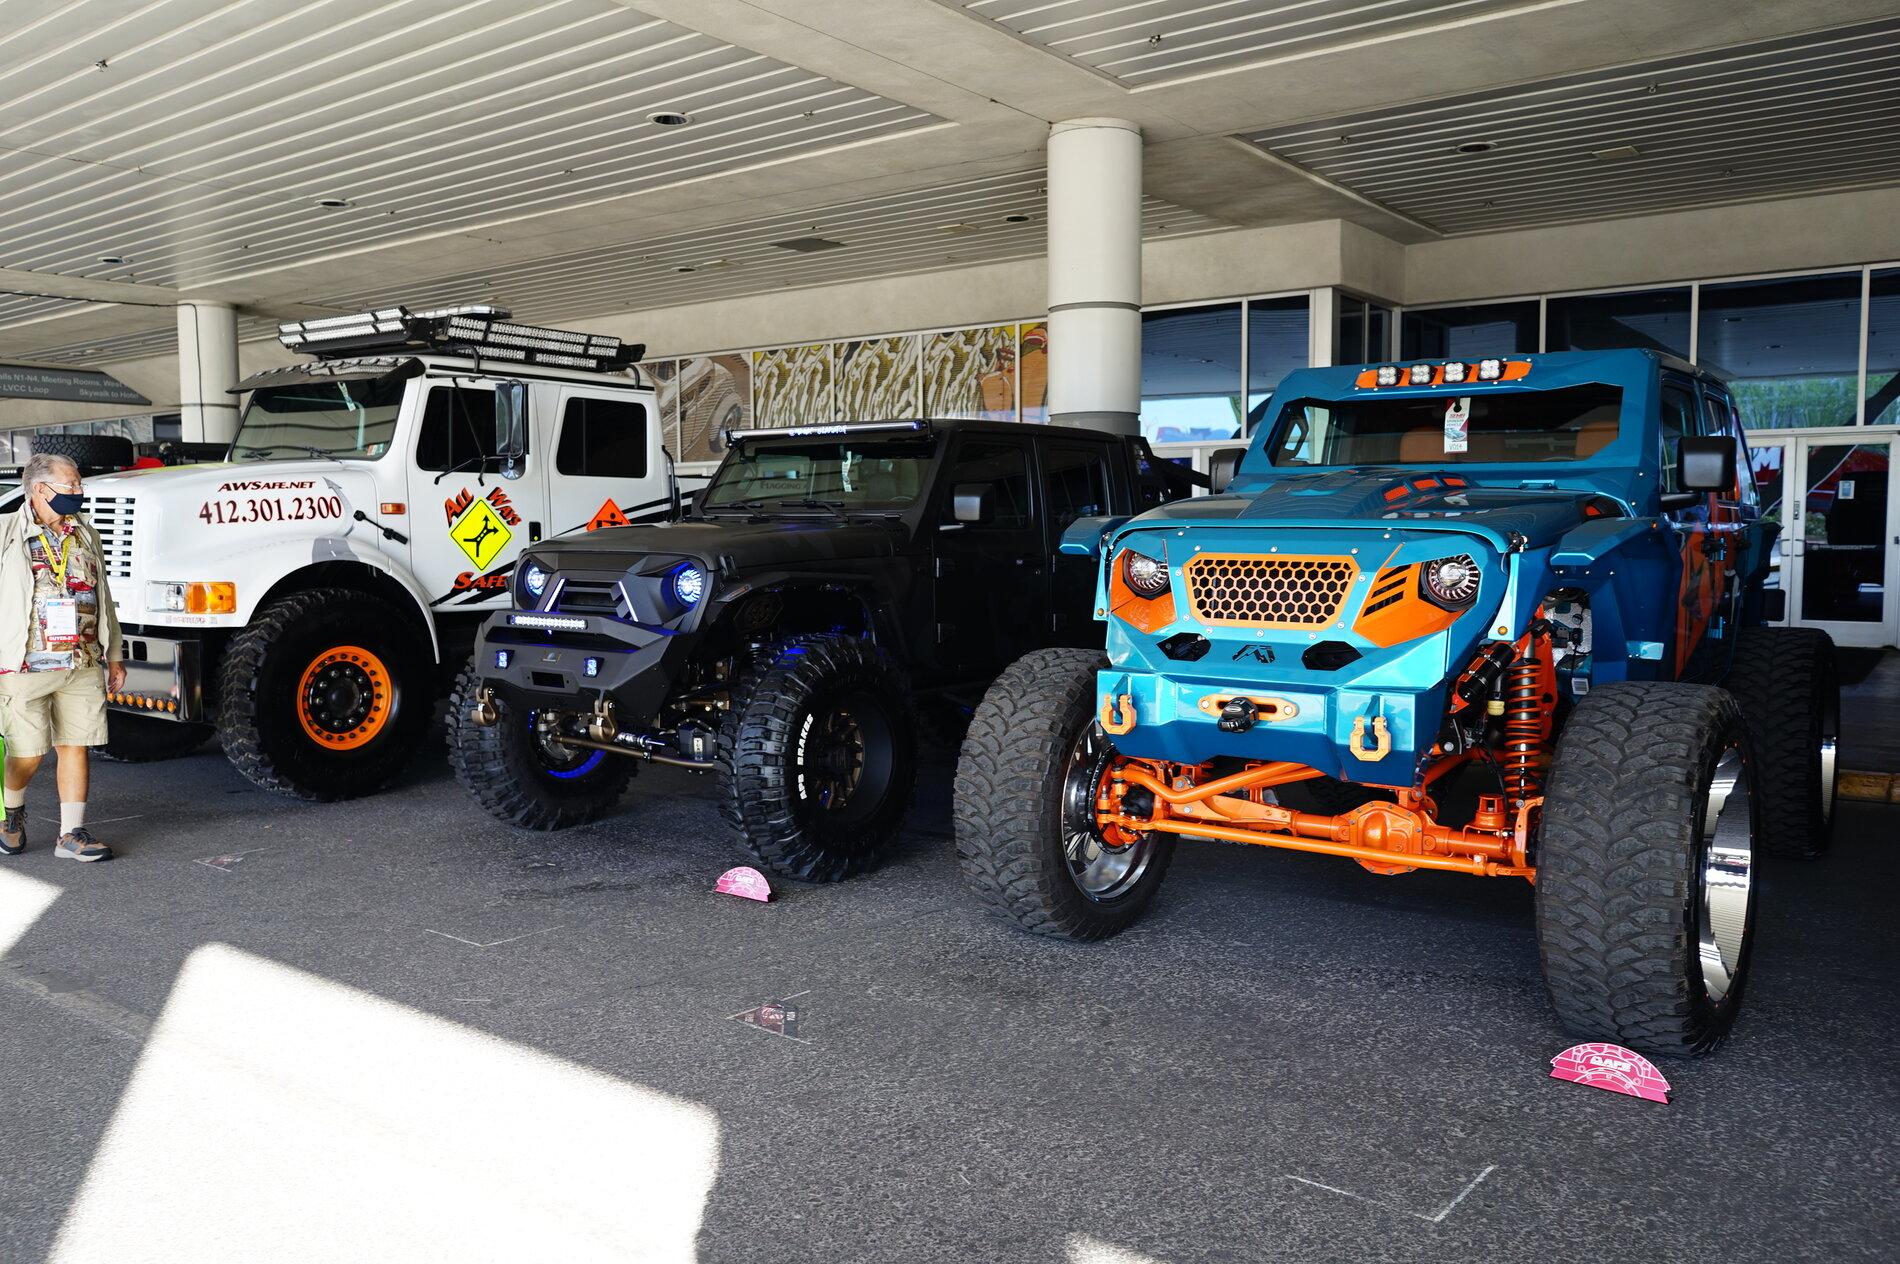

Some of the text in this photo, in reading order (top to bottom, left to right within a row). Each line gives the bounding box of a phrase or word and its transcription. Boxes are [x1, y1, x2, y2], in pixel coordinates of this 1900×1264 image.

[3, 384, 50, 396] LVCC Loop
[42, 375, 72, 386] Meeting
[199, 496, 342, 525] 412.301.2300
[486, 486, 522, 526] WAYS
[453, 571, 508, 590] SAFE
[797, 713, 814, 766] BRAKES
